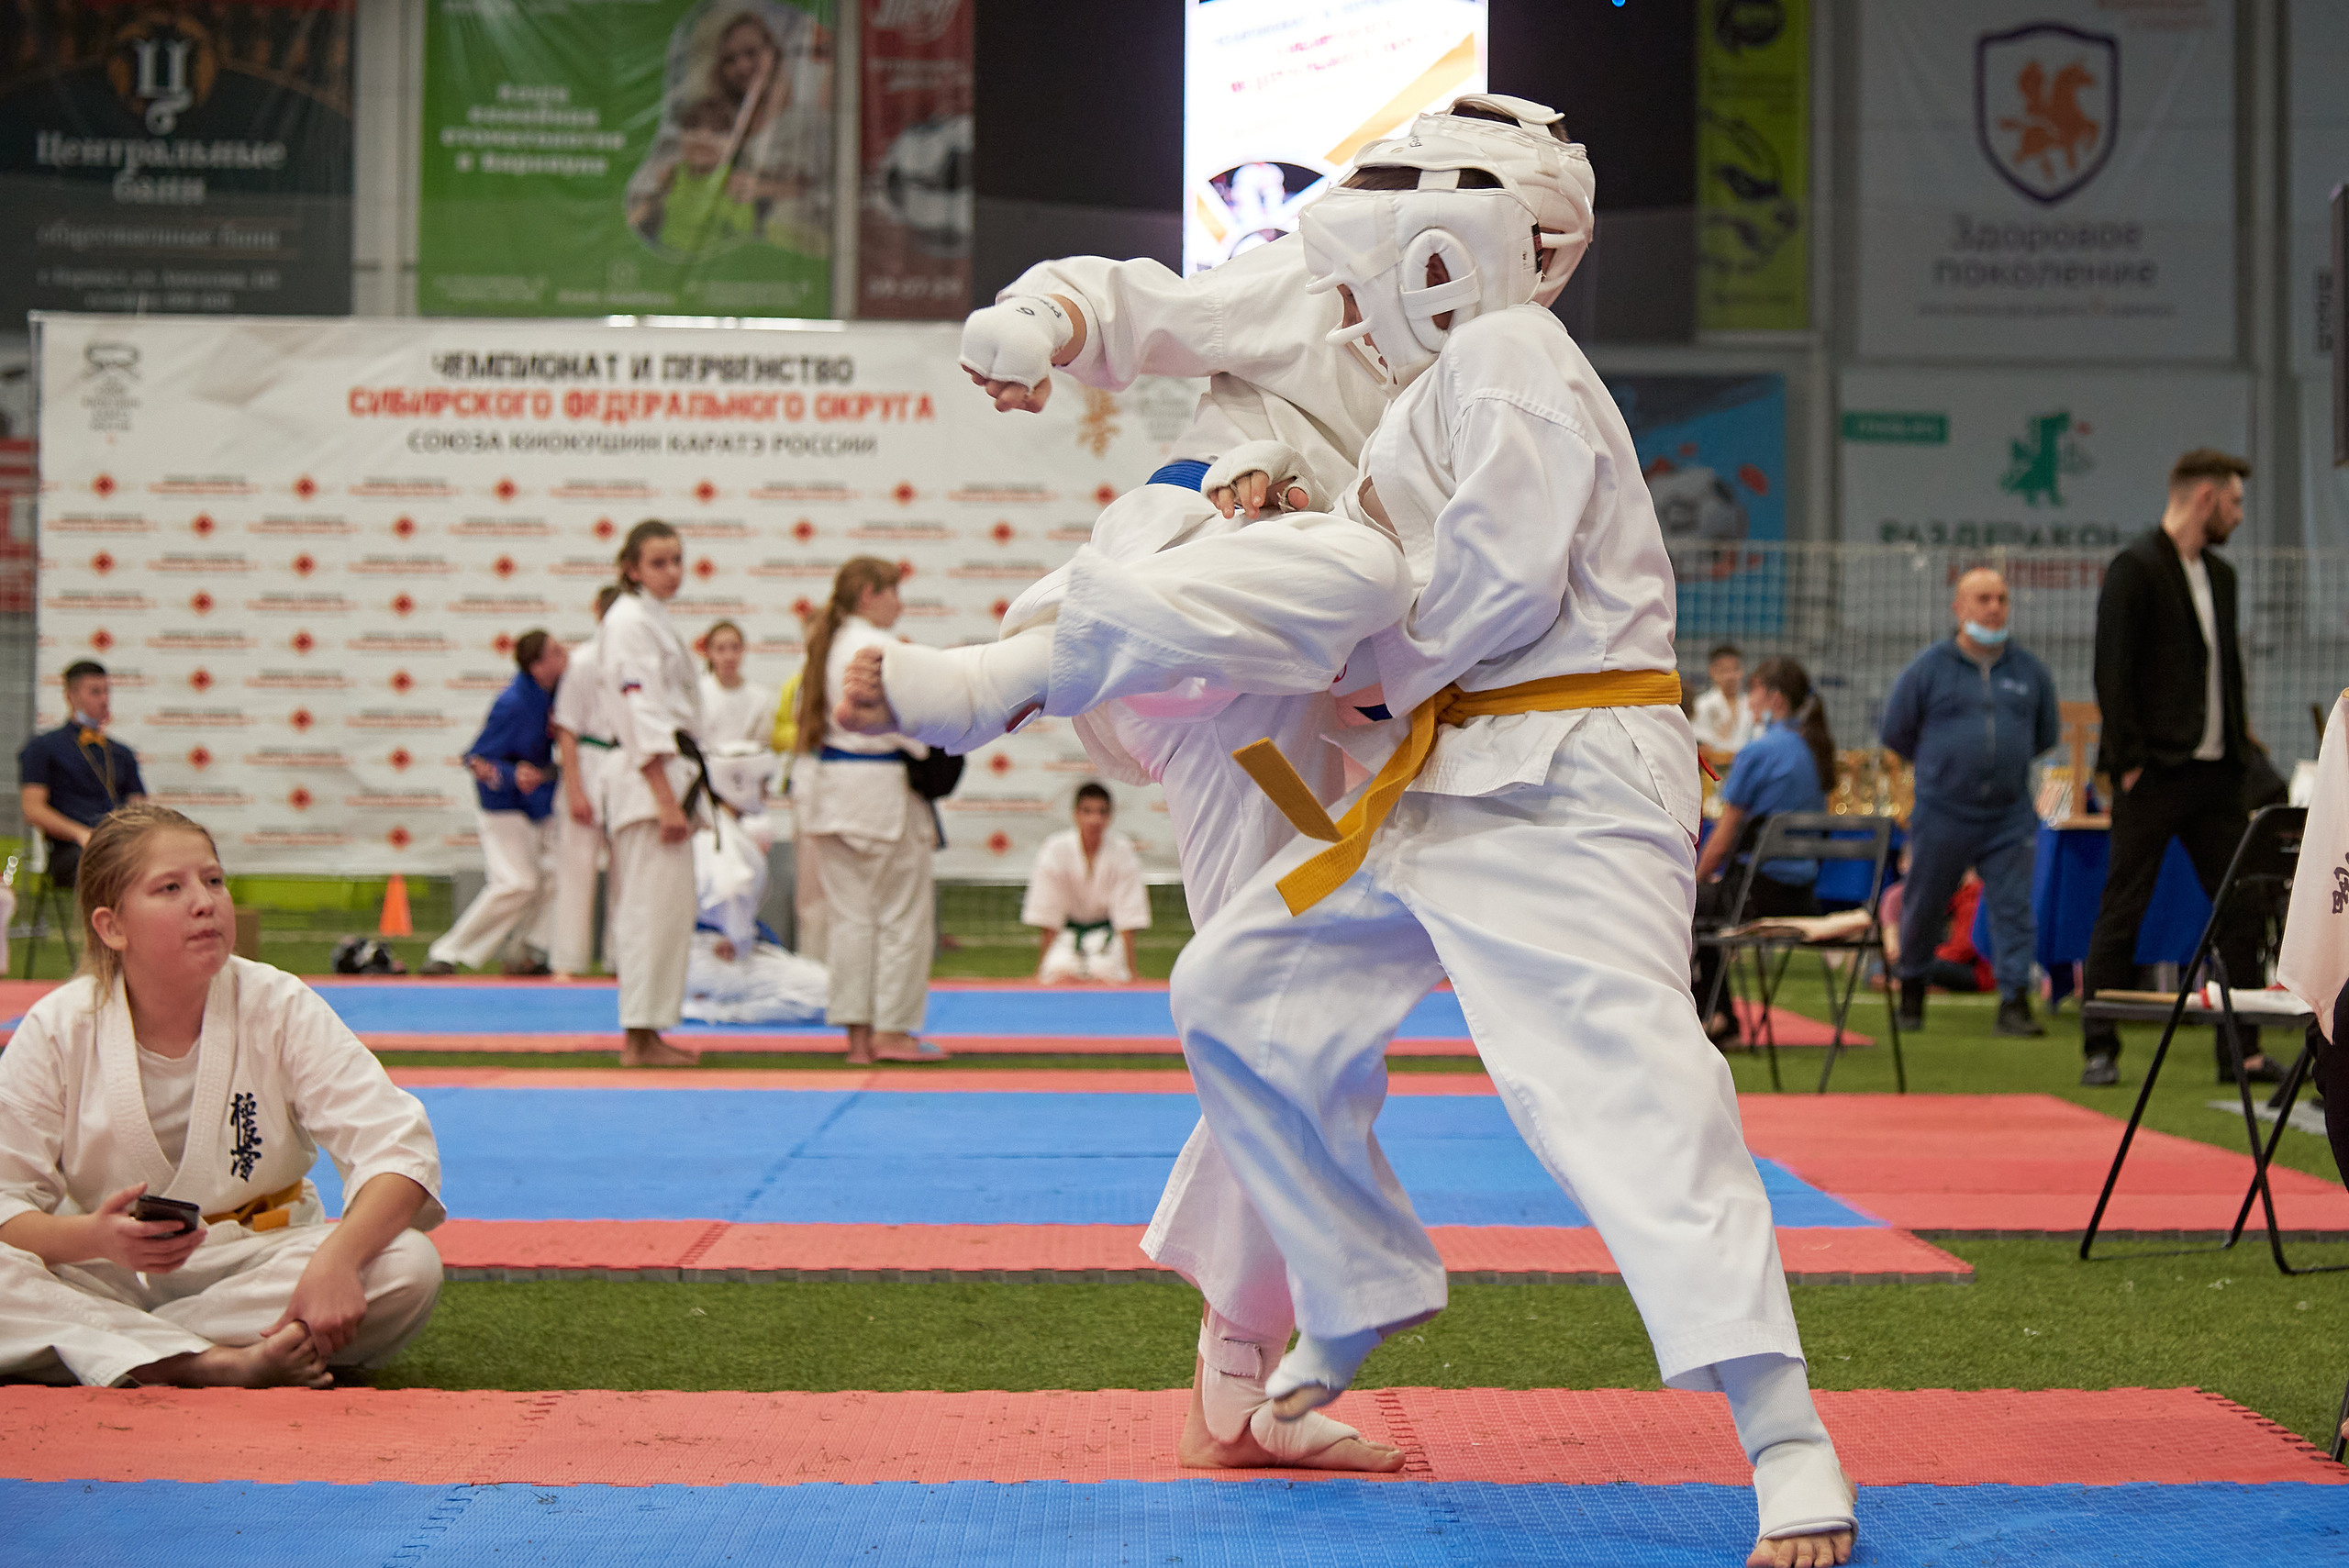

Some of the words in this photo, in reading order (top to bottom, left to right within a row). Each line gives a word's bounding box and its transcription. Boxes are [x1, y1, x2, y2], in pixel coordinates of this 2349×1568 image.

[37, 130, 287, 175] Центральные
[113, 173, 206, 205] бани
[1951, 215, 2143, 251] Здоровое
[1934, 260, 2156, 287] поколение
[431, 351, 618, 382] ЧЕМПИОНАТ
[630, 353, 652, 382] И
[662, 352, 854, 384] ПЕРВЕНСТВО
[348, 385, 552, 417] СИБИРСКОГО
[563, 388, 805, 425] ФЕДЕРАЛЬНОГО
[815, 391, 935, 422] ОКРУГА
[407, 428, 502, 454] СОЮЗА
[508, 430, 662, 455] КИОКУШИН
[666, 432, 765, 455] КАРАТЭ
[771, 433, 878, 457] РОССИИ
